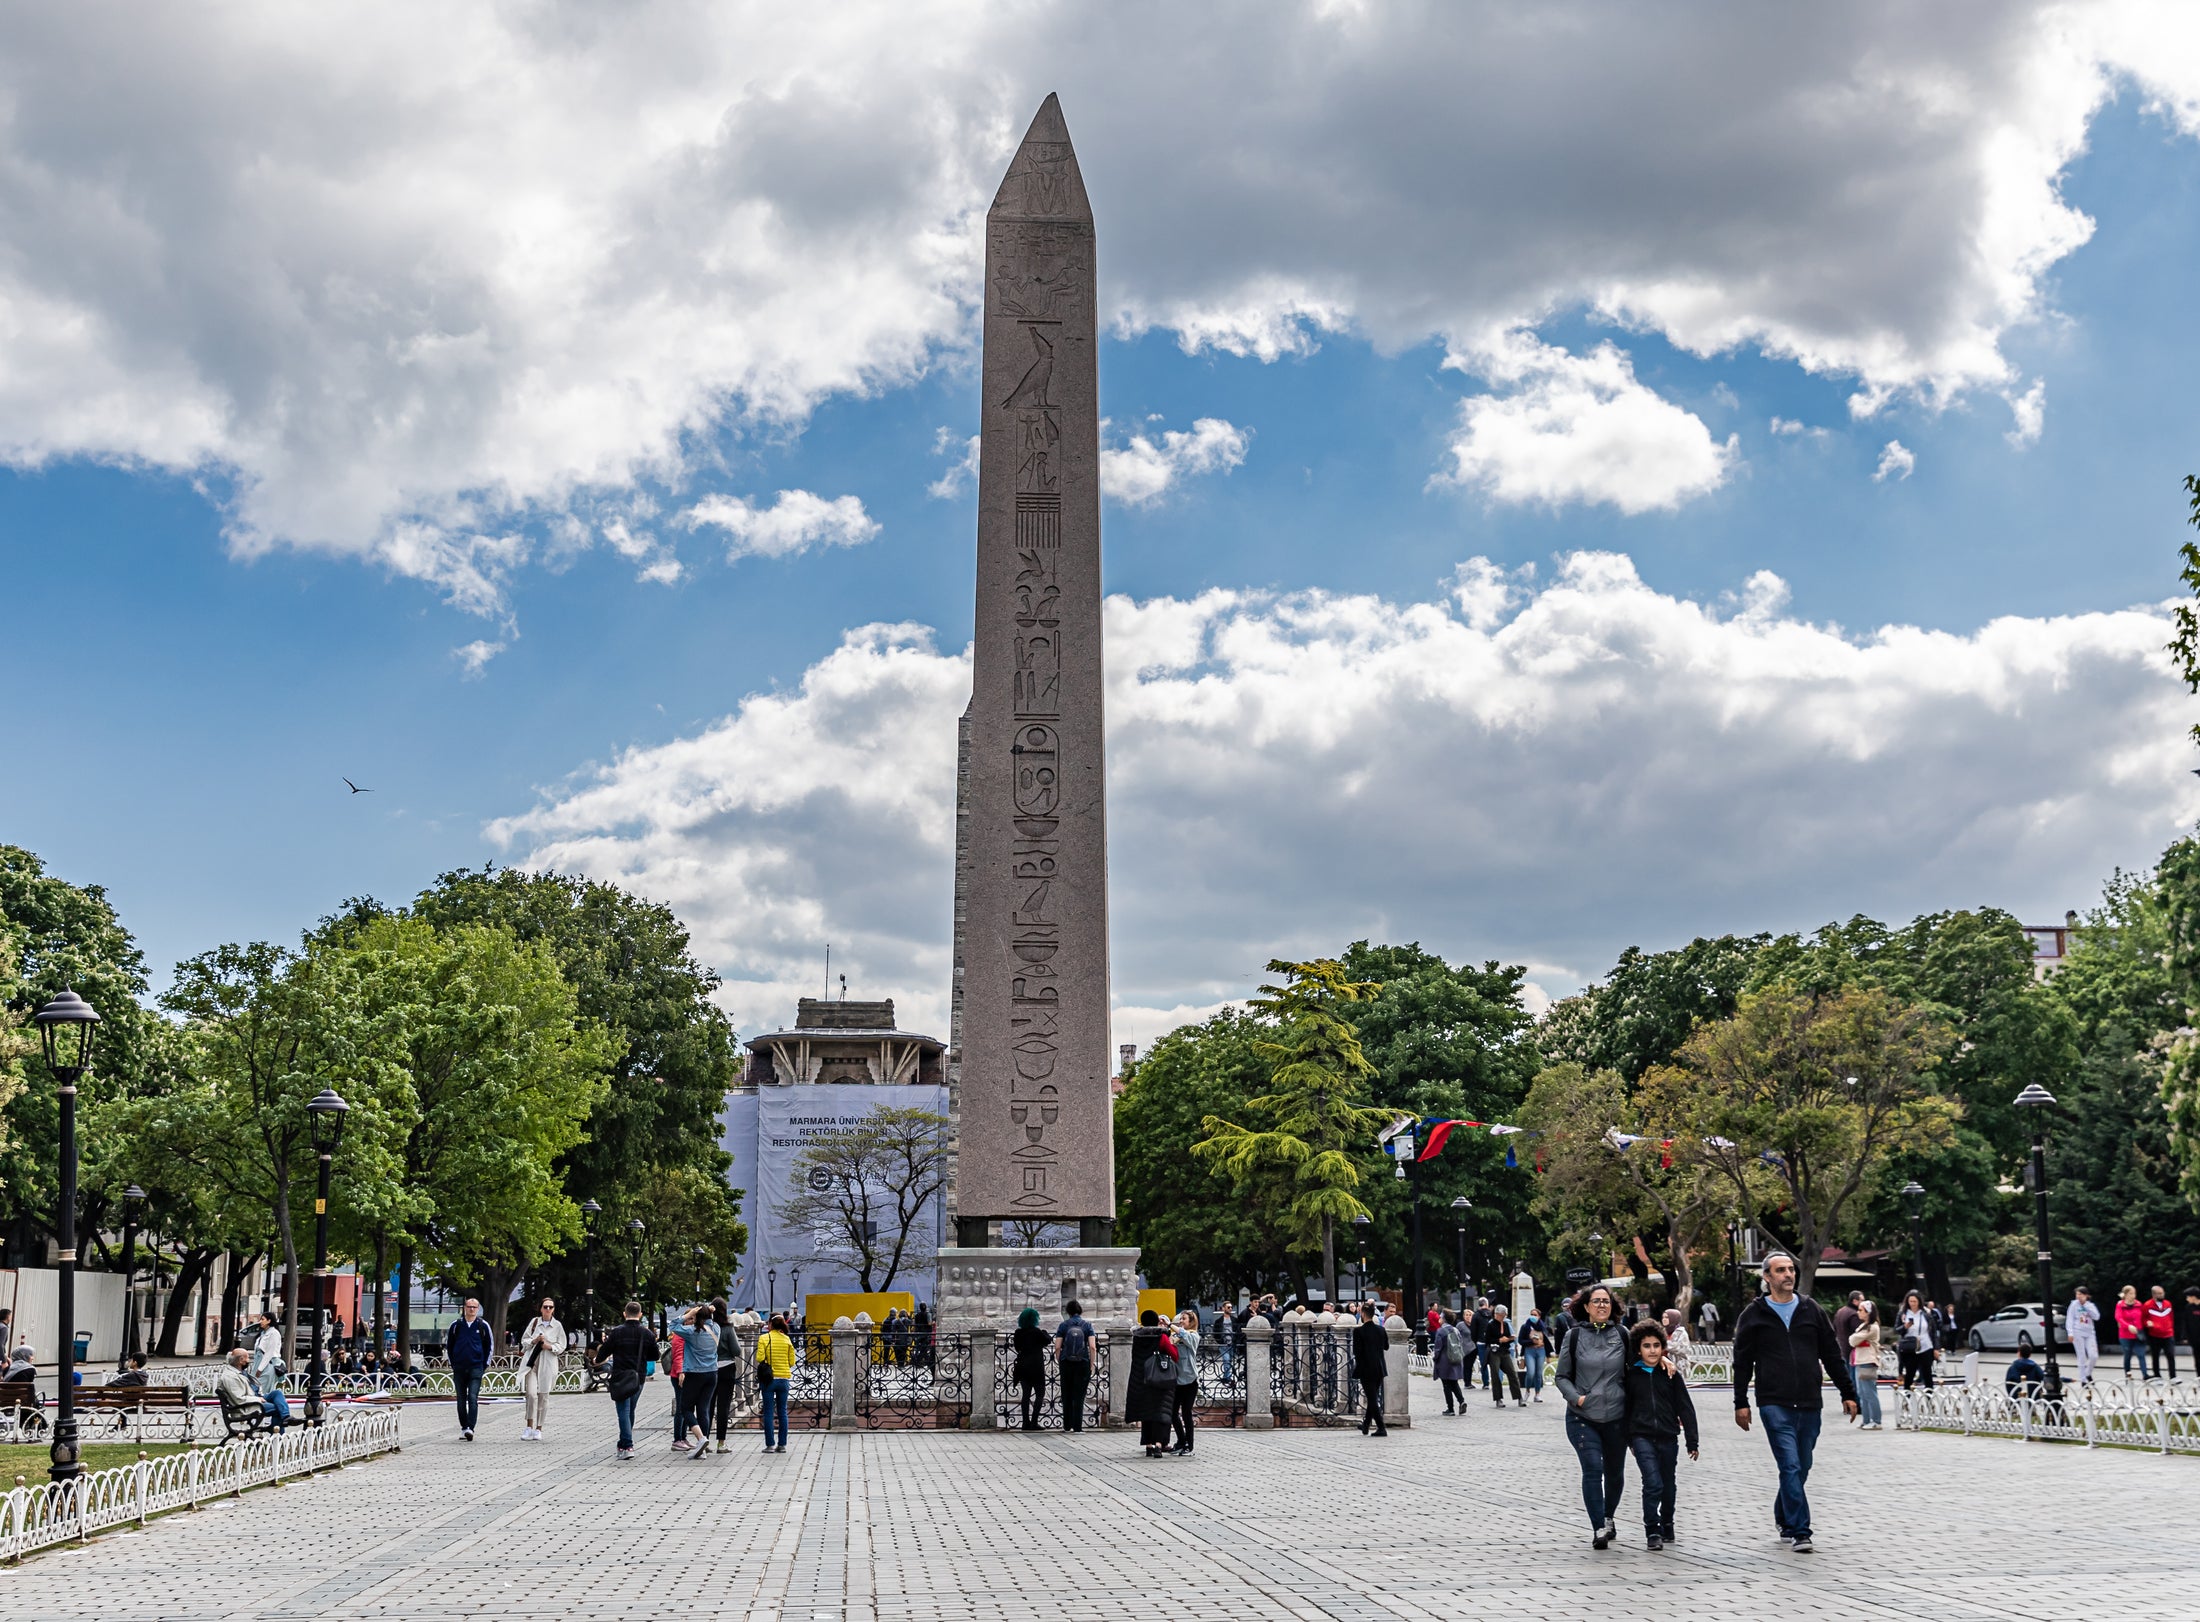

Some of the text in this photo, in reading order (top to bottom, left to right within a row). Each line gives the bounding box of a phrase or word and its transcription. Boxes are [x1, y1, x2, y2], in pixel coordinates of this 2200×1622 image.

[790, 1115, 902, 1125] MARMARA ÜNİVERSİT
[799, 1127, 855, 1136] REKTÖRLÜK
[1032, 1238, 1058, 1248] RUP
